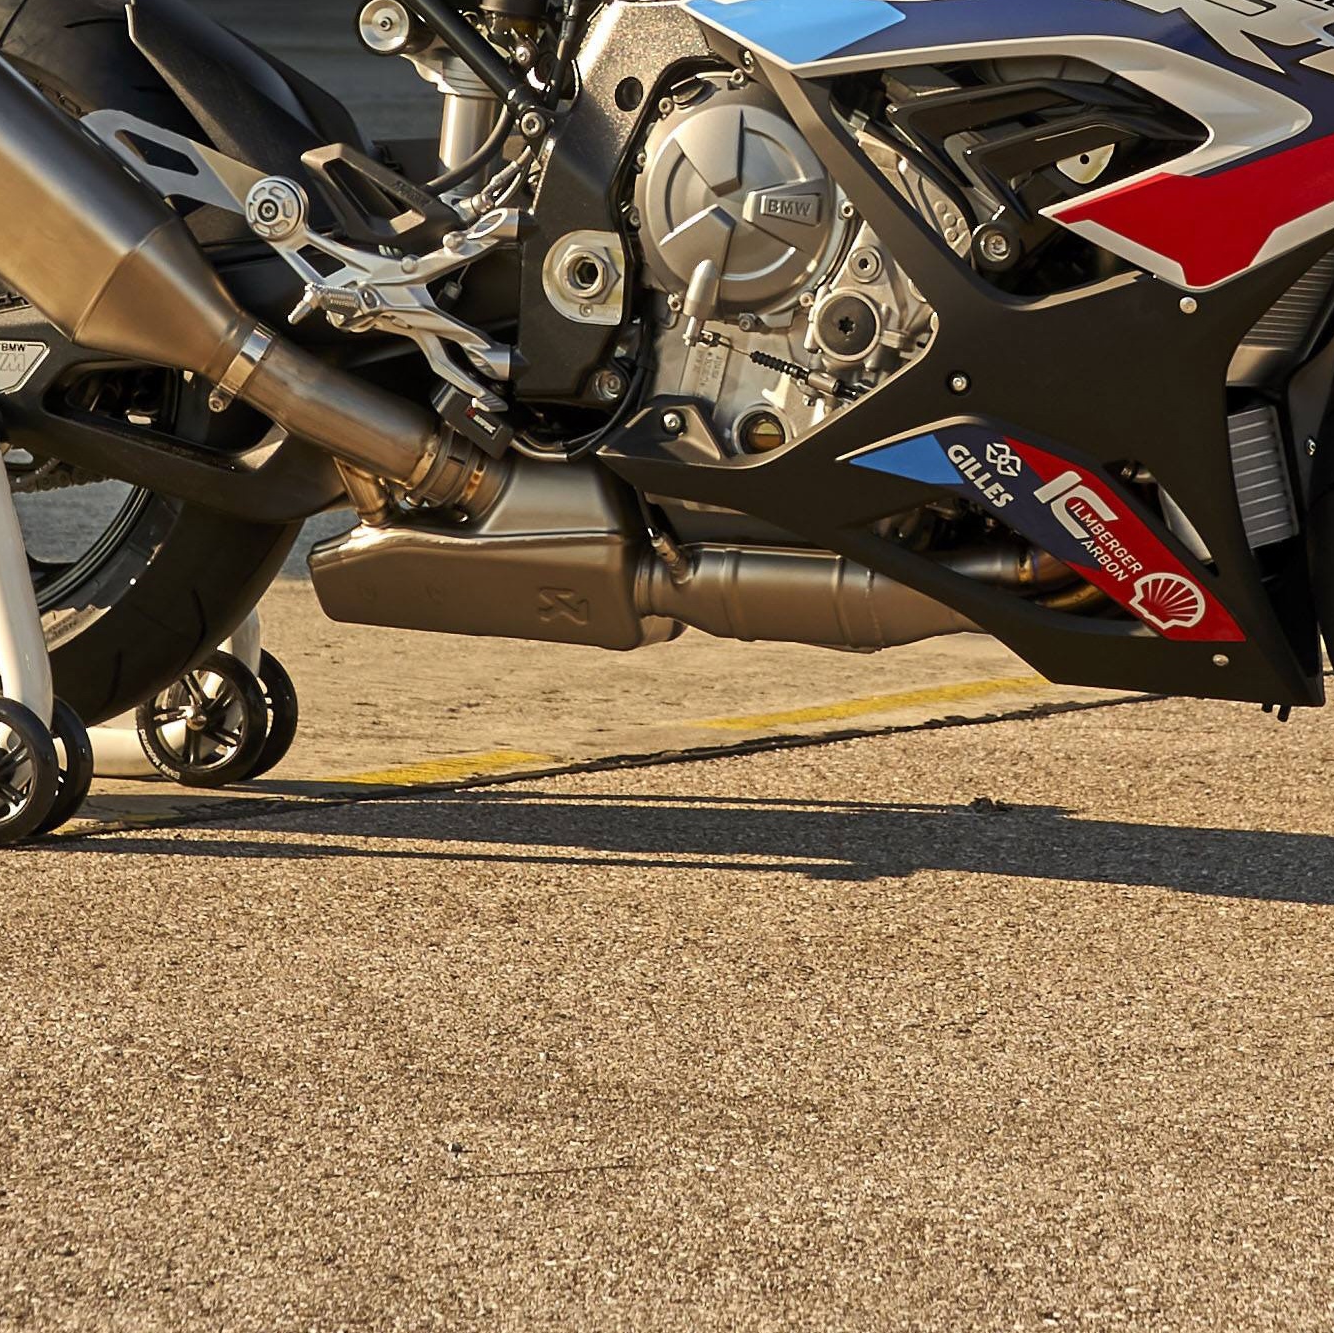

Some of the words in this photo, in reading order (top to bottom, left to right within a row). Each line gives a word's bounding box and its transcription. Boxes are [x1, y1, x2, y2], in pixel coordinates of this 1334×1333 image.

[767, 200, 812, 214] BMW
[1, 343, 26, 352] BMW
[947, 444, 1014, 508] GILLES
[1070, 501, 1143, 574] ILMBERGER
